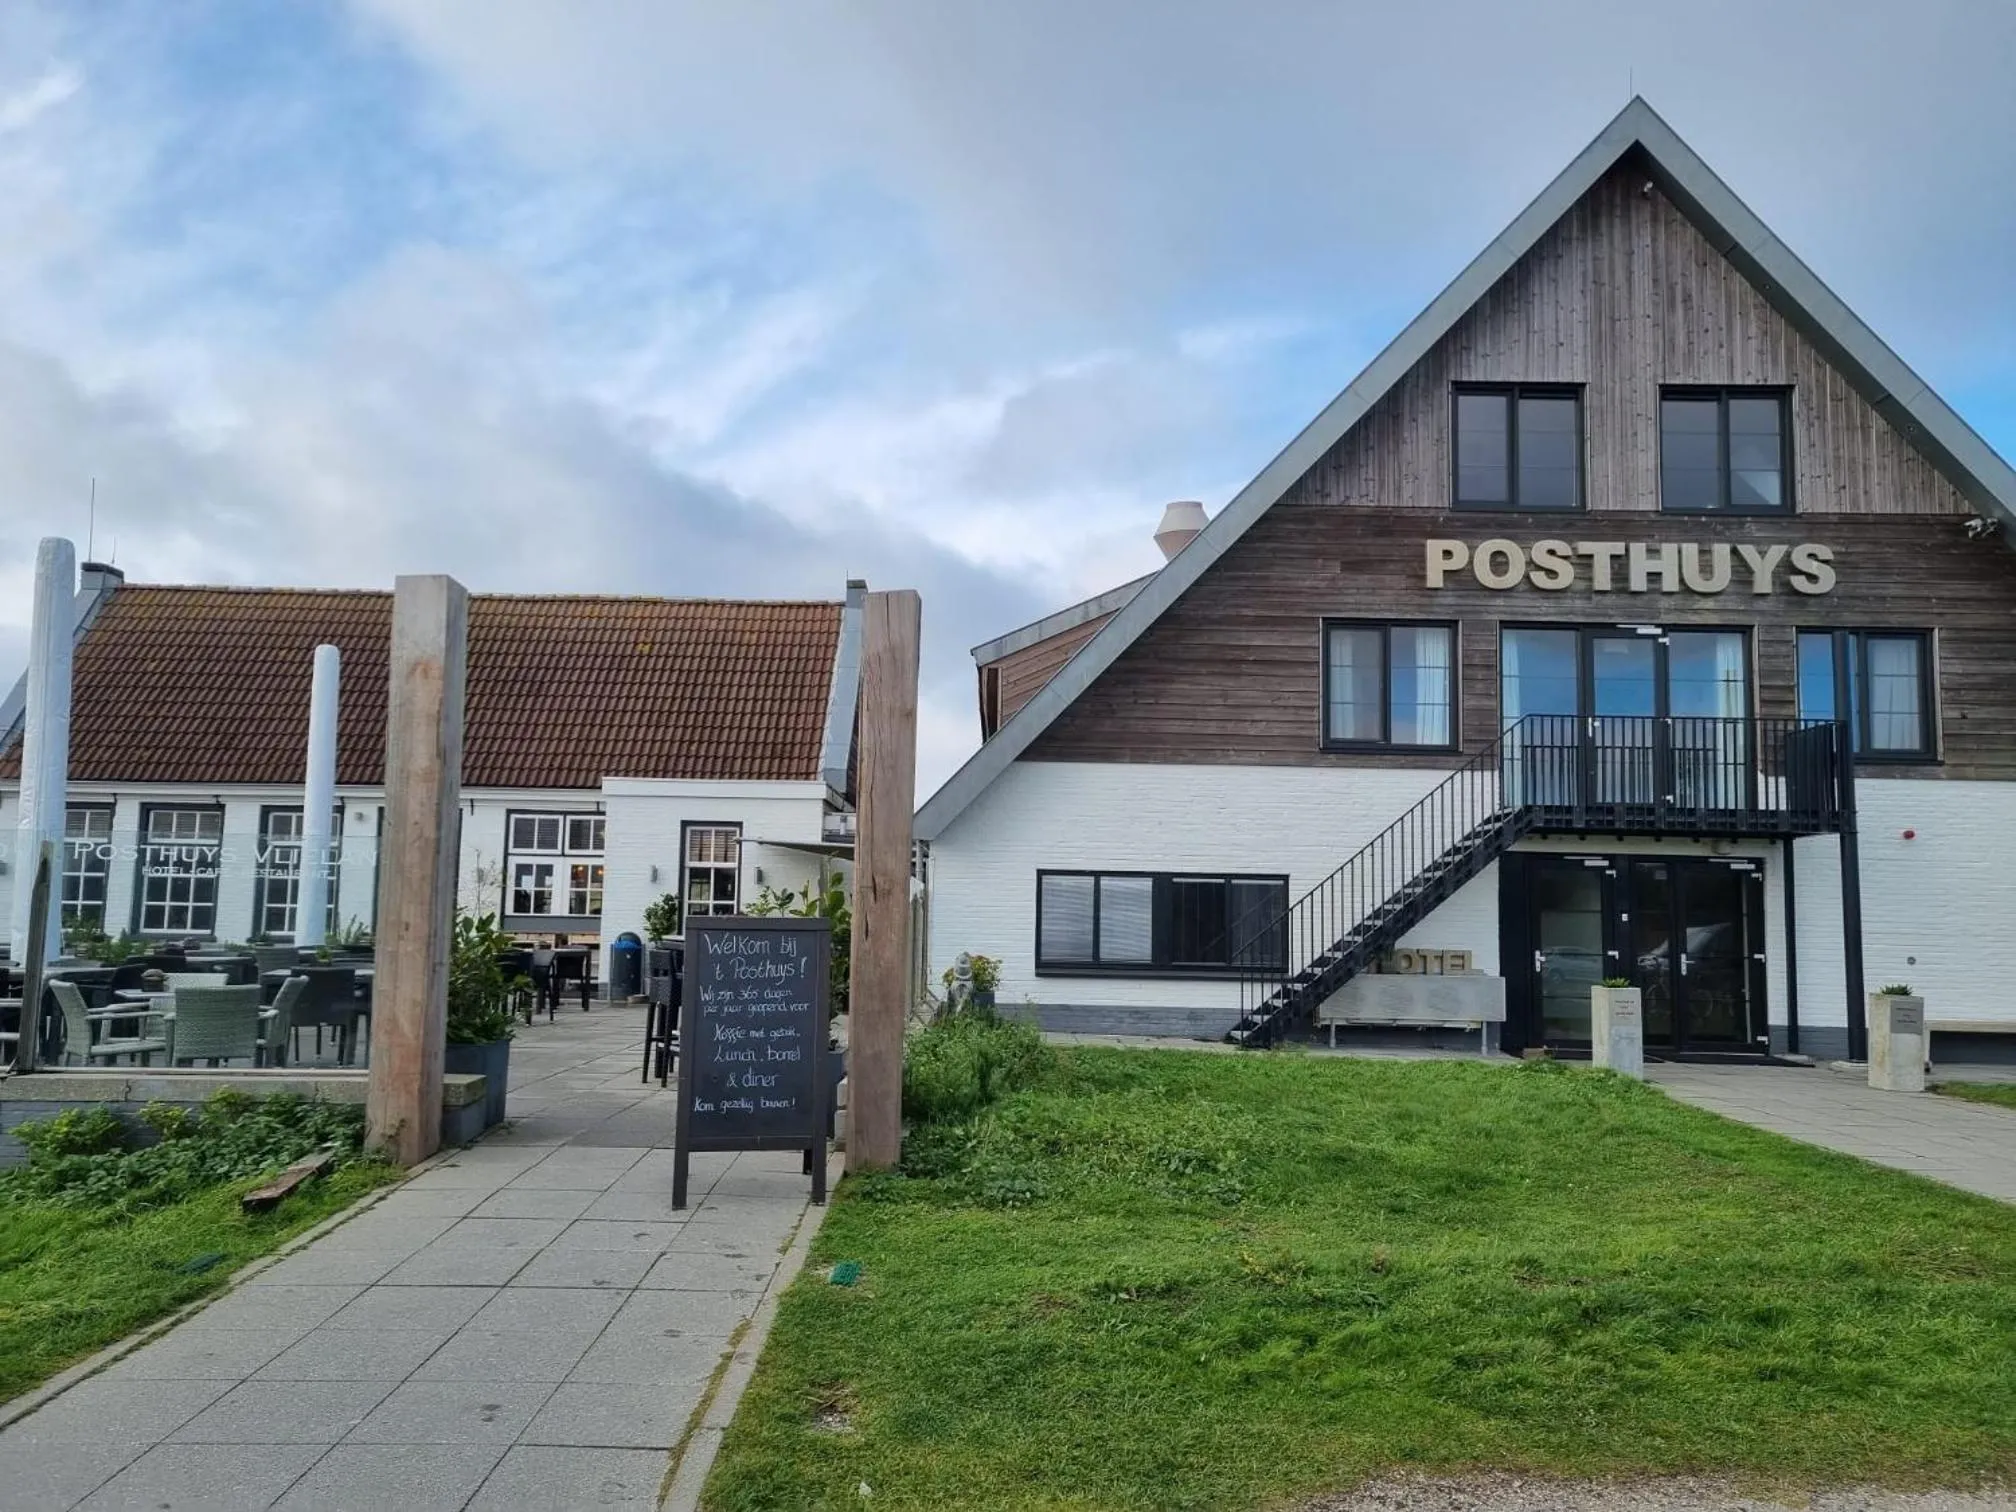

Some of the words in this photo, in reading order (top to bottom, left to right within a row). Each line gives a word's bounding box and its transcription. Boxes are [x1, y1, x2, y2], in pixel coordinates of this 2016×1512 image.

[1426, 538, 1837, 595] POSTHUYS
[74, 840, 236, 863] POSTHUYS
[142, 866, 184, 876] HOTEL
[780, 935, 798, 957] bij
[789, 1002, 811, 1012] voor
[742, 1065, 781, 1088] diner
[694, 1096, 715, 1113] Kom
